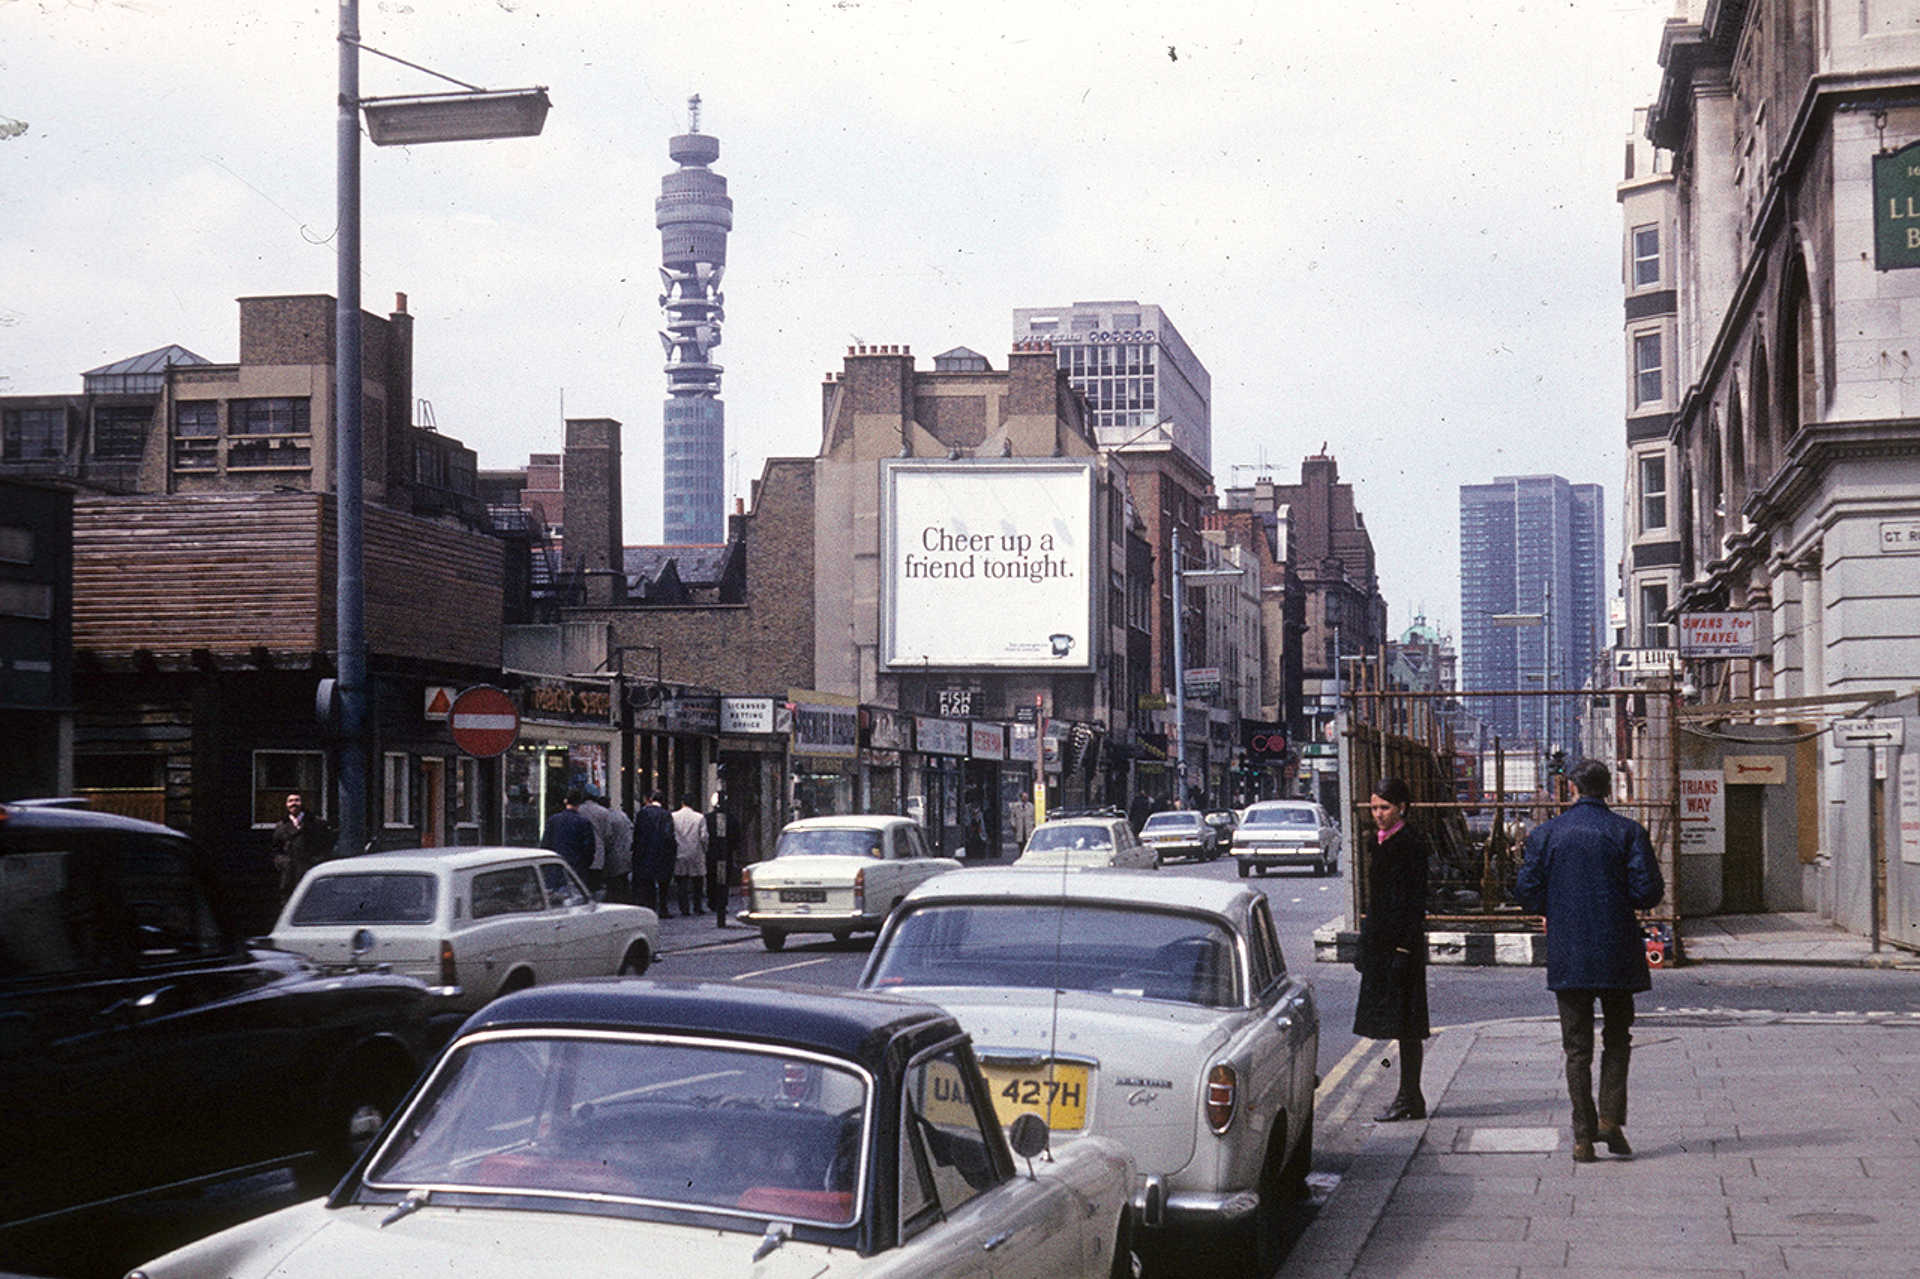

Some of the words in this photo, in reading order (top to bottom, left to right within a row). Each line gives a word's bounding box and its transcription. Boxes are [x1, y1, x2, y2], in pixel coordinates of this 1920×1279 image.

[1889, 197, 1920, 219] LL
[1906, 227, 1920, 249] B
[922, 526, 994, 552] Cheer
[1000, 533, 1032, 557] up
[1039, 533, 1055, 552] a
[905, 553, 975, 579] friend
[983, 554, 1074, 583] tonight.
[1682, 617, 1723, 630] SWANS
[1730, 616, 1752, 629] for
[1695, 631, 1739, 644] TRAVEL
[939, 691, 971, 705] FISH
[940, 704, 970, 716] BAR
[1681, 779, 1718, 795] TRIANS
[1686, 797, 1711, 812] WAY
[934, 1077, 990, 1104] UA
[1002, 1079, 1081, 1107] 427H
